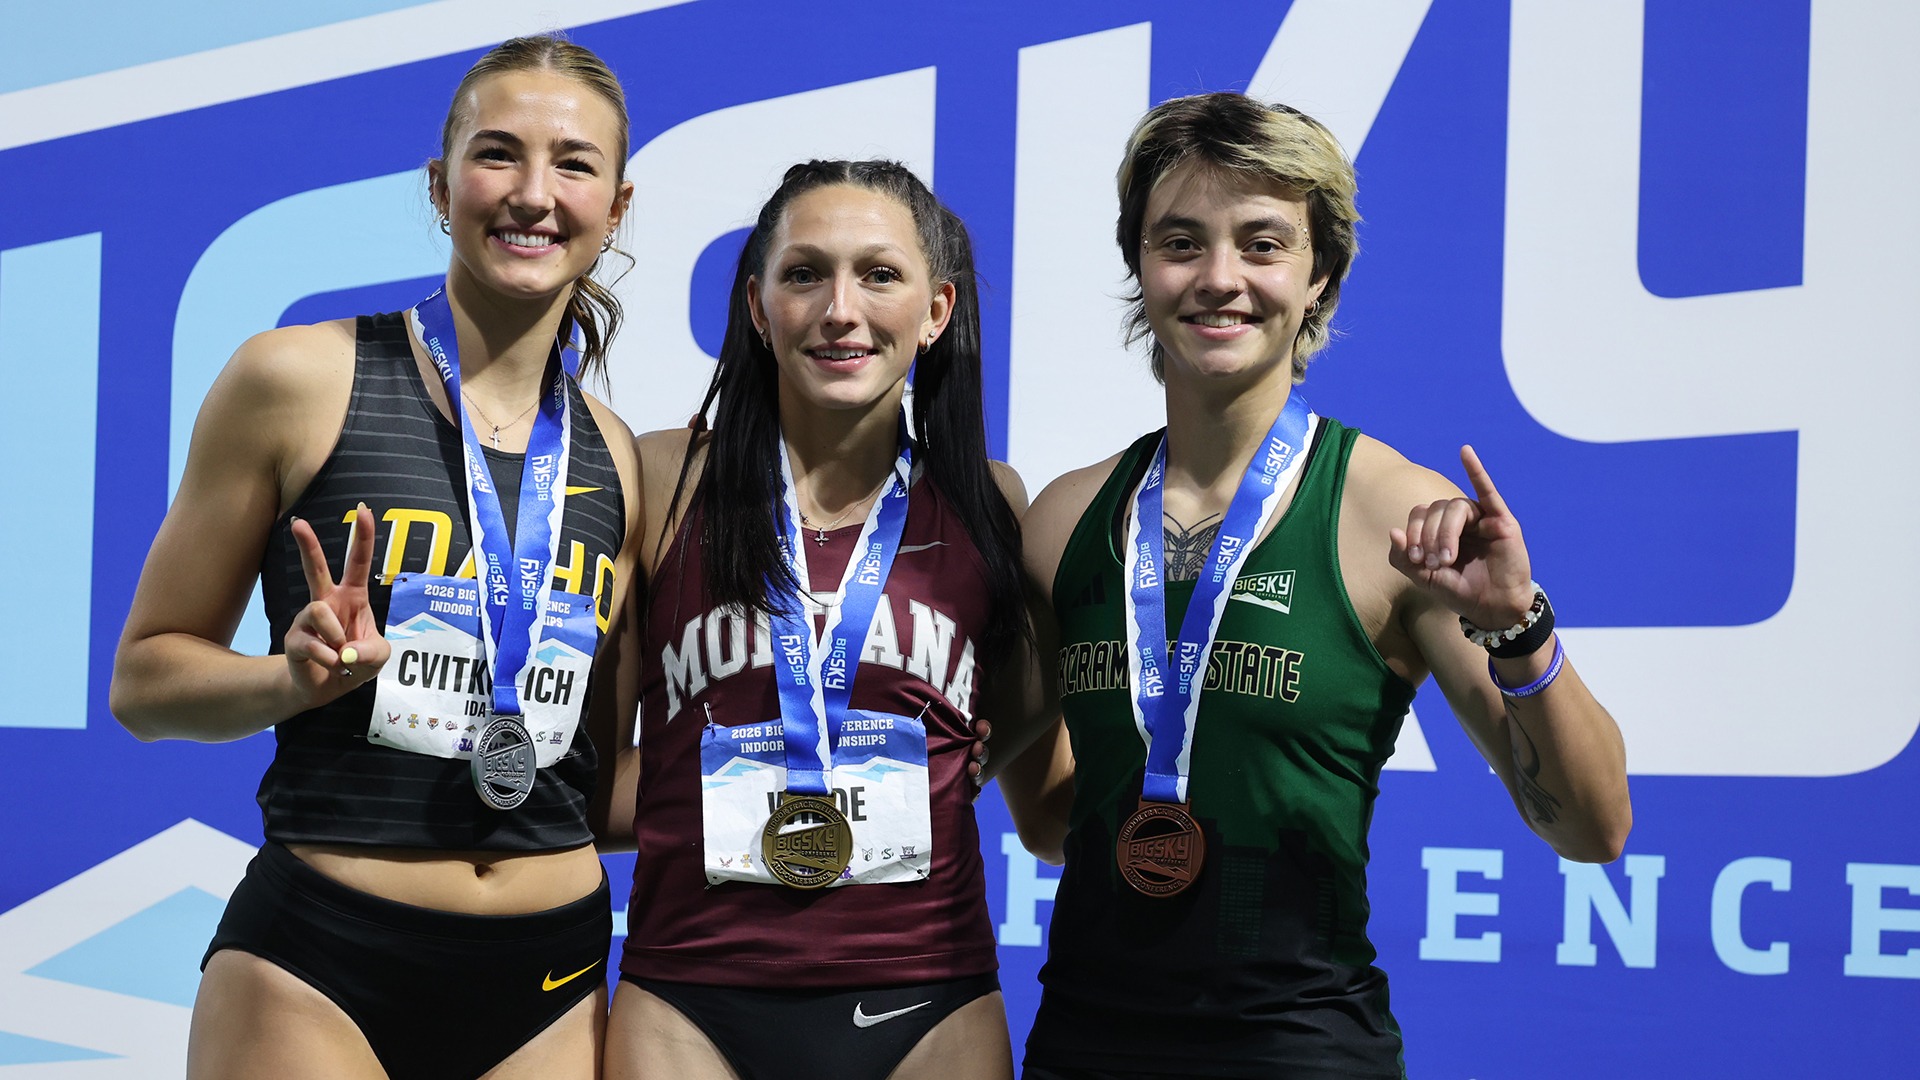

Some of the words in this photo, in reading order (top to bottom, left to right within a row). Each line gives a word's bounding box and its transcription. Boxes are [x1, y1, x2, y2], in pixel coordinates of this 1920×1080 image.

[429, 336, 454, 382] BIGSKY
[465, 442, 493, 494] BIGSKY
[531, 454, 552, 501] BIGSKY
[1261, 436, 1292, 486] BIGSKY
[342, 507, 616, 634] DHO
[488, 553, 509, 606] BIGSKY
[520, 557, 539, 610] BIGSKY
[859, 543, 882, 585] BIGSKY
[1140, 542, 1158, 588] BIGSKY
[1213, 535, 1241, 583] BIGSKY
[424, 584, 454, 599] 2026
[457, 586, 477, 600] BIG
[429, 600, 473, 617] INDOOR
[1234, 574, 1292, 596] BIGSKY
[397, 650, 575, 706] CVITKICH
[661, 591, 976, 724] MOANA
[779, 634, 806, 686] BIGSKY
[825, 638, 847, 690] BIGSKY
[1142, 647, 1165, 698] BIGSKY
[1179, 642, 1199, 694] BIGSKY
[1202, 640, 1305, 704] STATE
[731, 726, 762, 739] 2026
[841, 719, 894, 732] FERENCE
[740, 740, 785, 754] INDOOR
[776, 828, 837, 852] BIGSKY
[1129, 835, 1189, 860] BIGSKY
